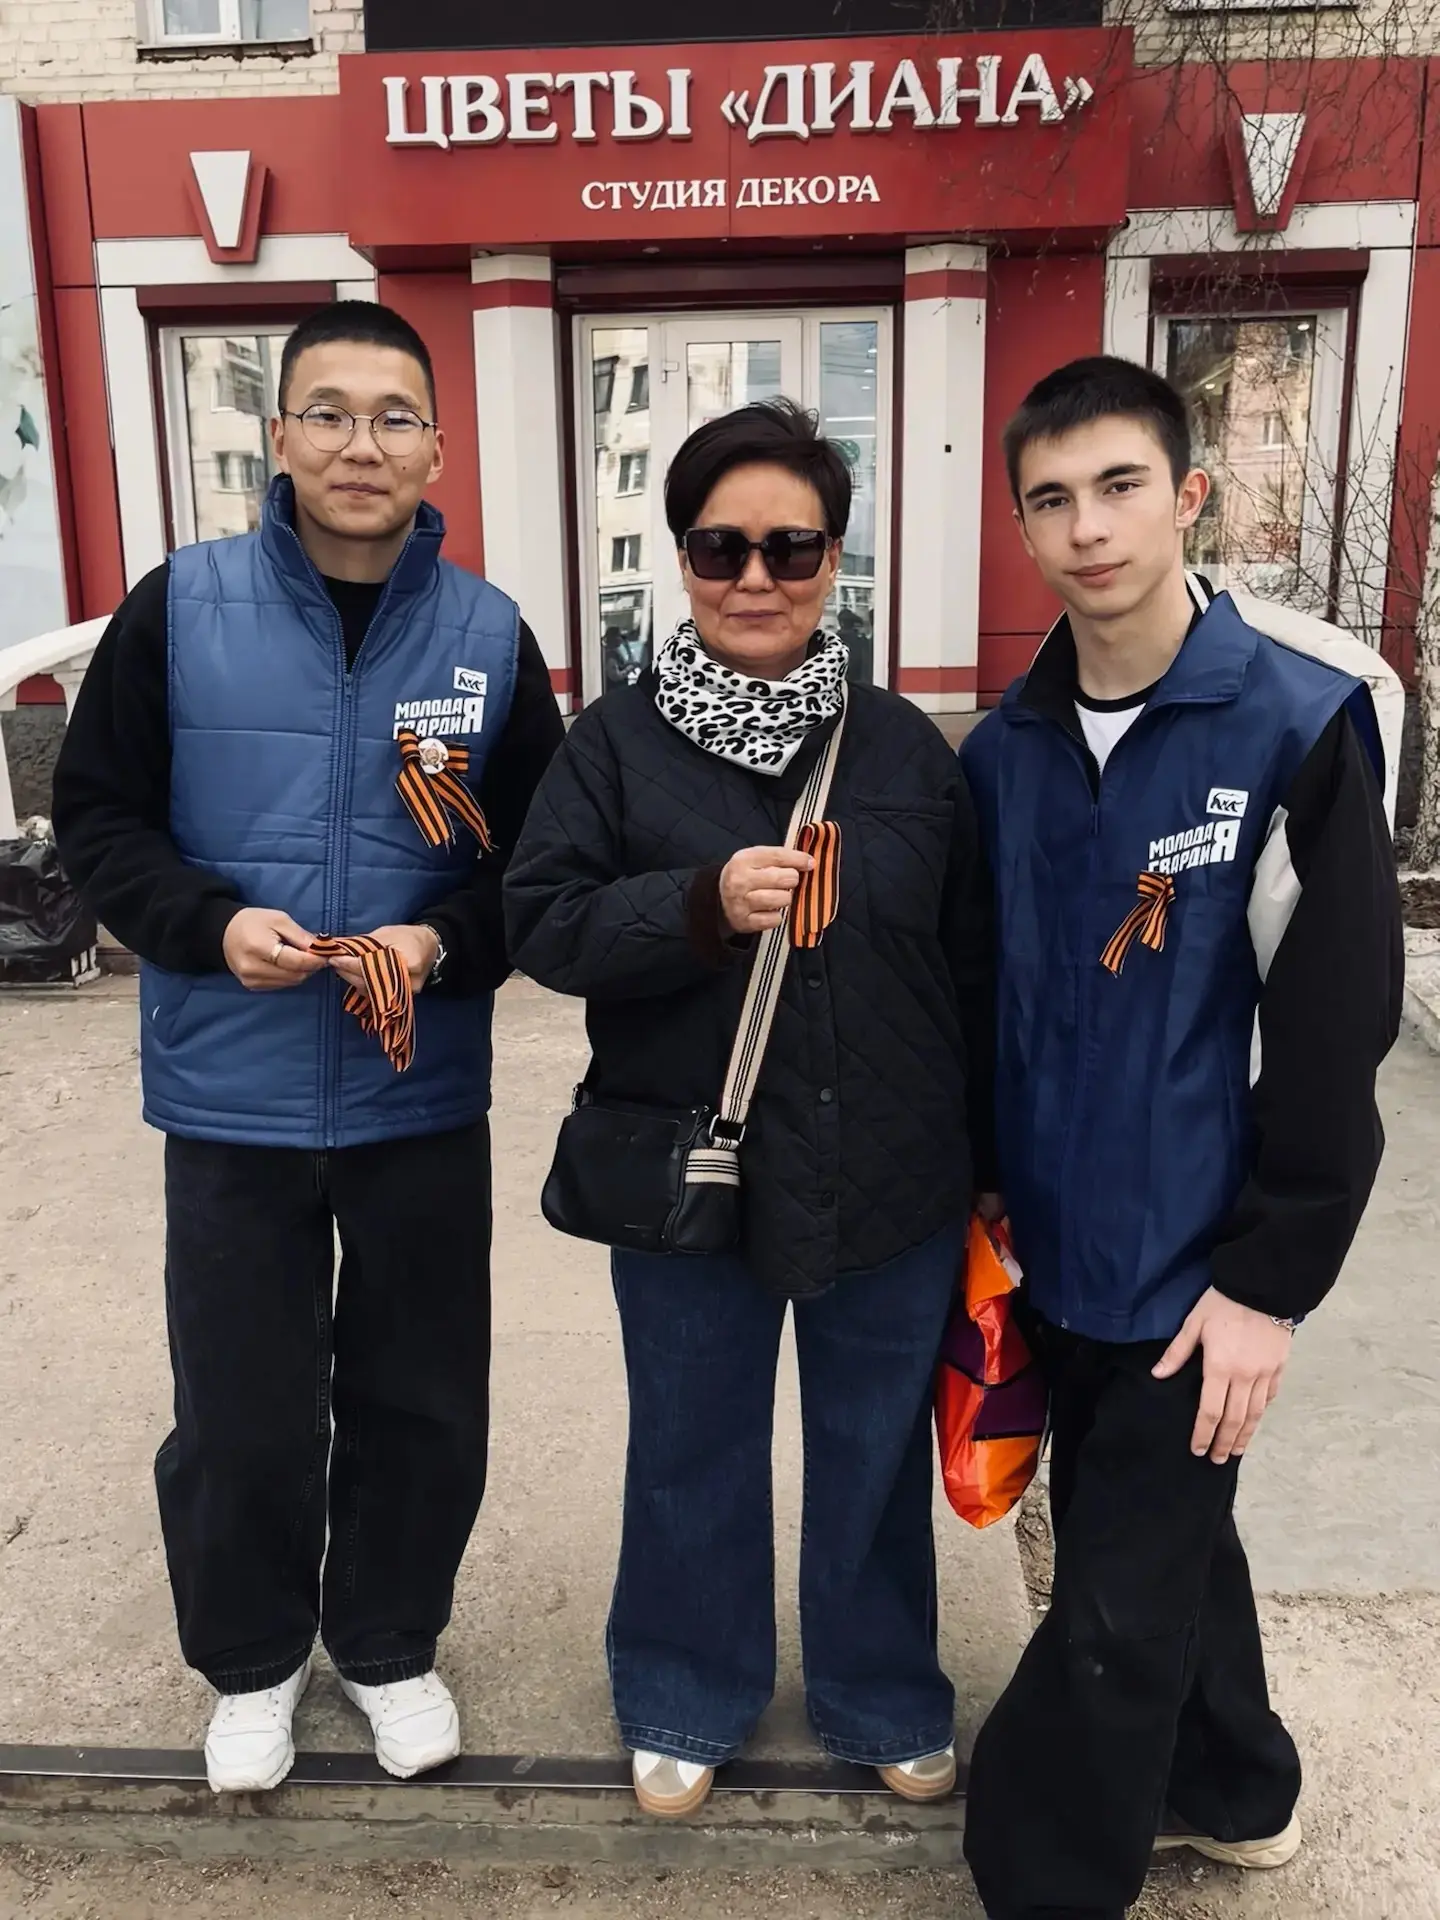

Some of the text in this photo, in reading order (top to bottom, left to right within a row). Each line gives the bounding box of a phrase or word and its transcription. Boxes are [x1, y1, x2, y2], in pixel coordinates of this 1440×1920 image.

[382, 53, 1094, 150] ЦВЕТЫ «ДИАНА»
[581, 174, 881, 211] СТУДИЯ ДЕКОРА
